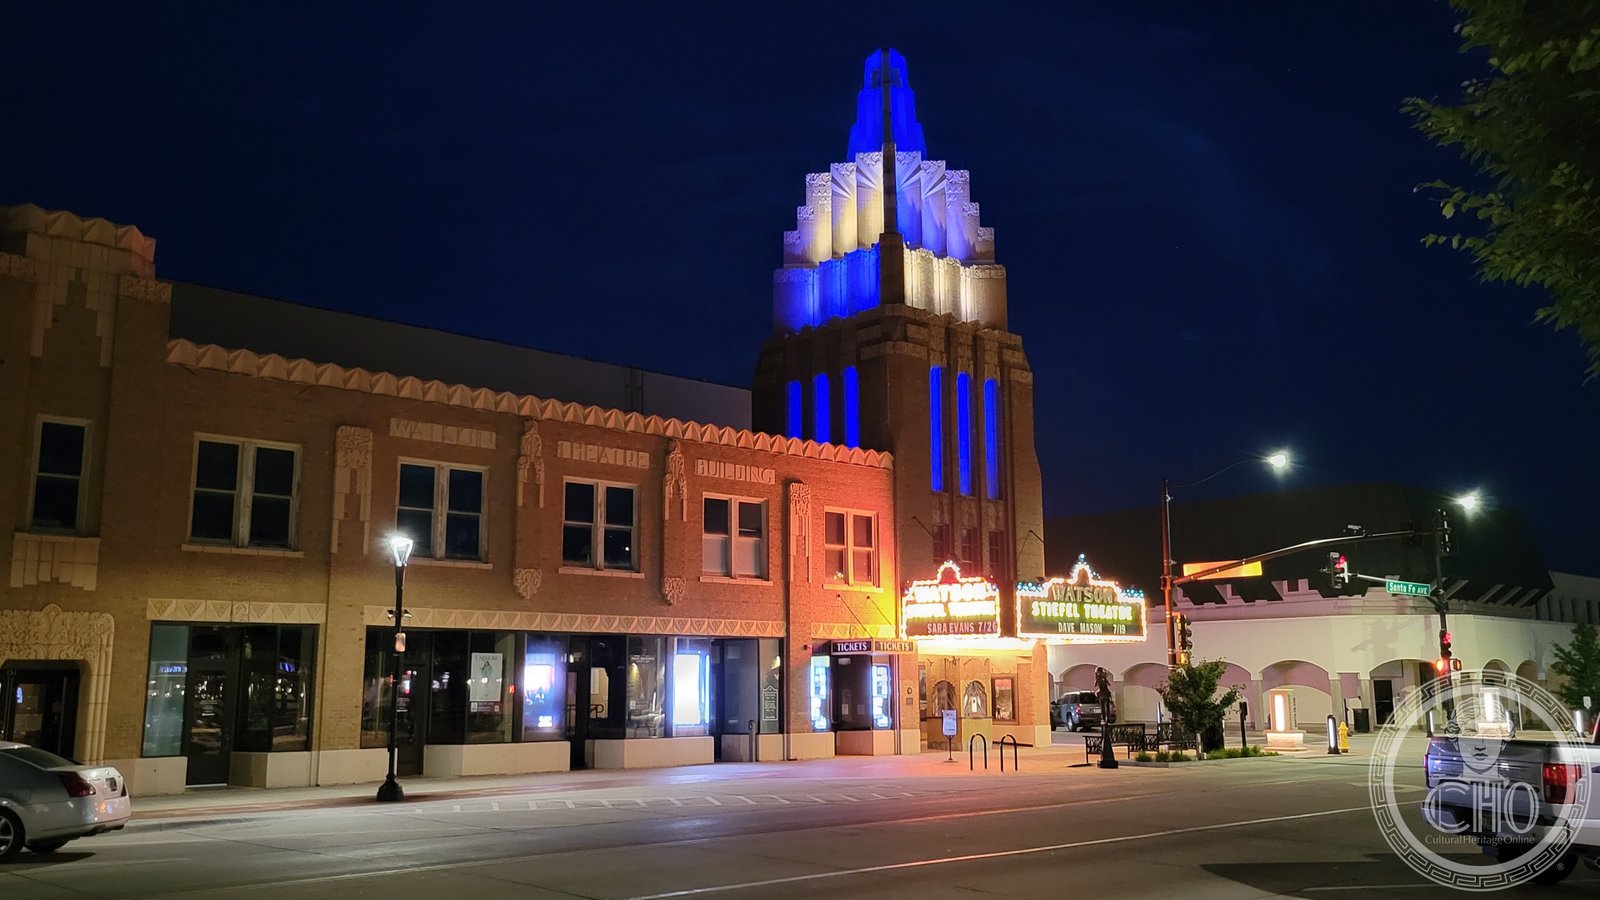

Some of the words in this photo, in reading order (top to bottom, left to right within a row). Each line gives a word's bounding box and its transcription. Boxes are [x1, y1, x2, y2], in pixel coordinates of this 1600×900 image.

[557, 440, 649, 469] THEATRE
[694, 458, 776, 485] BUILDING
[1051, 582, 1113, 603] WATSON
[1390, 582, 1407, 593] Santa
[1408, 584, 1416, 593] Fe
[1417, 587, 1428, 595] AVE
[1031, 601, 1080, 618] STIEFEL
[1084, 603, 1133, 620] THEATRE
[927, 622, 948, 634] SARA
[949, 622, 975, 633] EVANS
[1058, 622, 1076, 633] DAVE
[1079, 623, 1103, 634] MASON
[1113, 624, 1127, 634] 7/19
[836, 642, 868, 652] TICKETS
[879, 641, 910, 651] TICKETS
